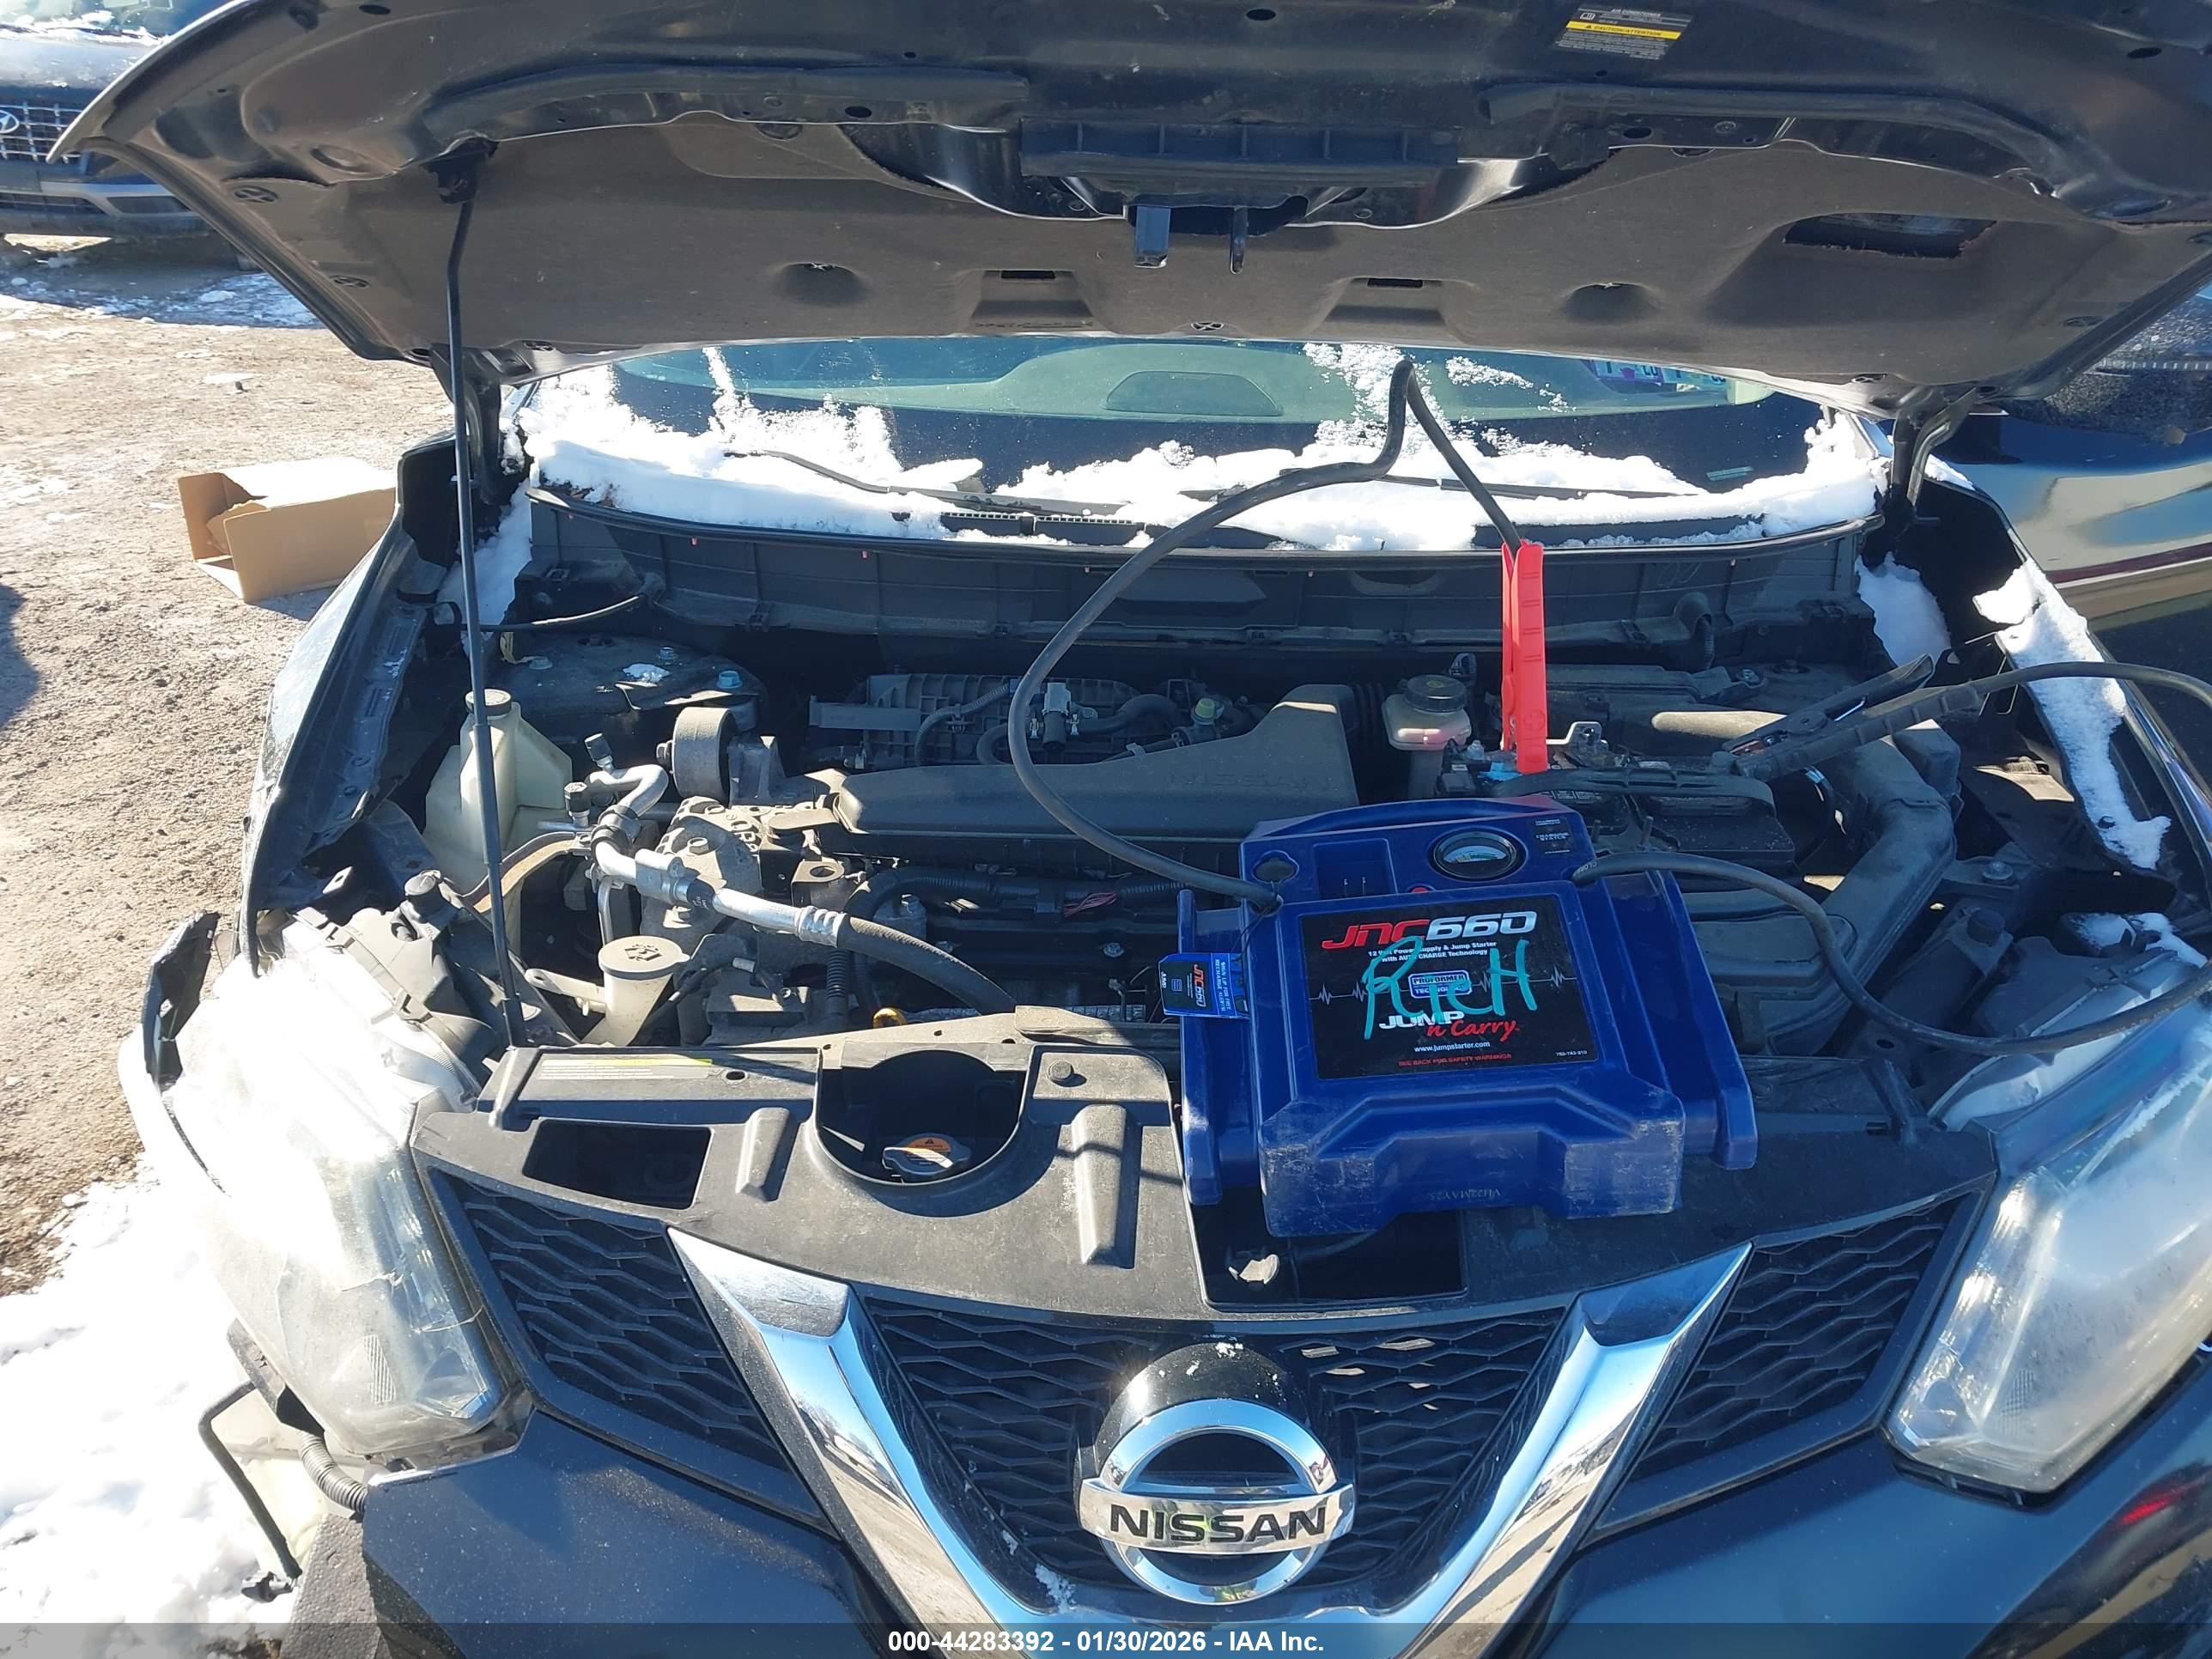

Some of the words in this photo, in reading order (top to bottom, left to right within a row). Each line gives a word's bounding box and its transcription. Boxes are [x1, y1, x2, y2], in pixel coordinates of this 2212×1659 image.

[1448, 949, 1488, 957] Technology
[1378, 1011, 1464, 1029] JUMP
[1427, 1024, 1447, 1037] n
[1450, 1020, 1516, 1042] Carry
[1413, 1041, 1491, 1052] www.jumpstarter.com
[1110, 1504, 1326, 1543] NISSAN
